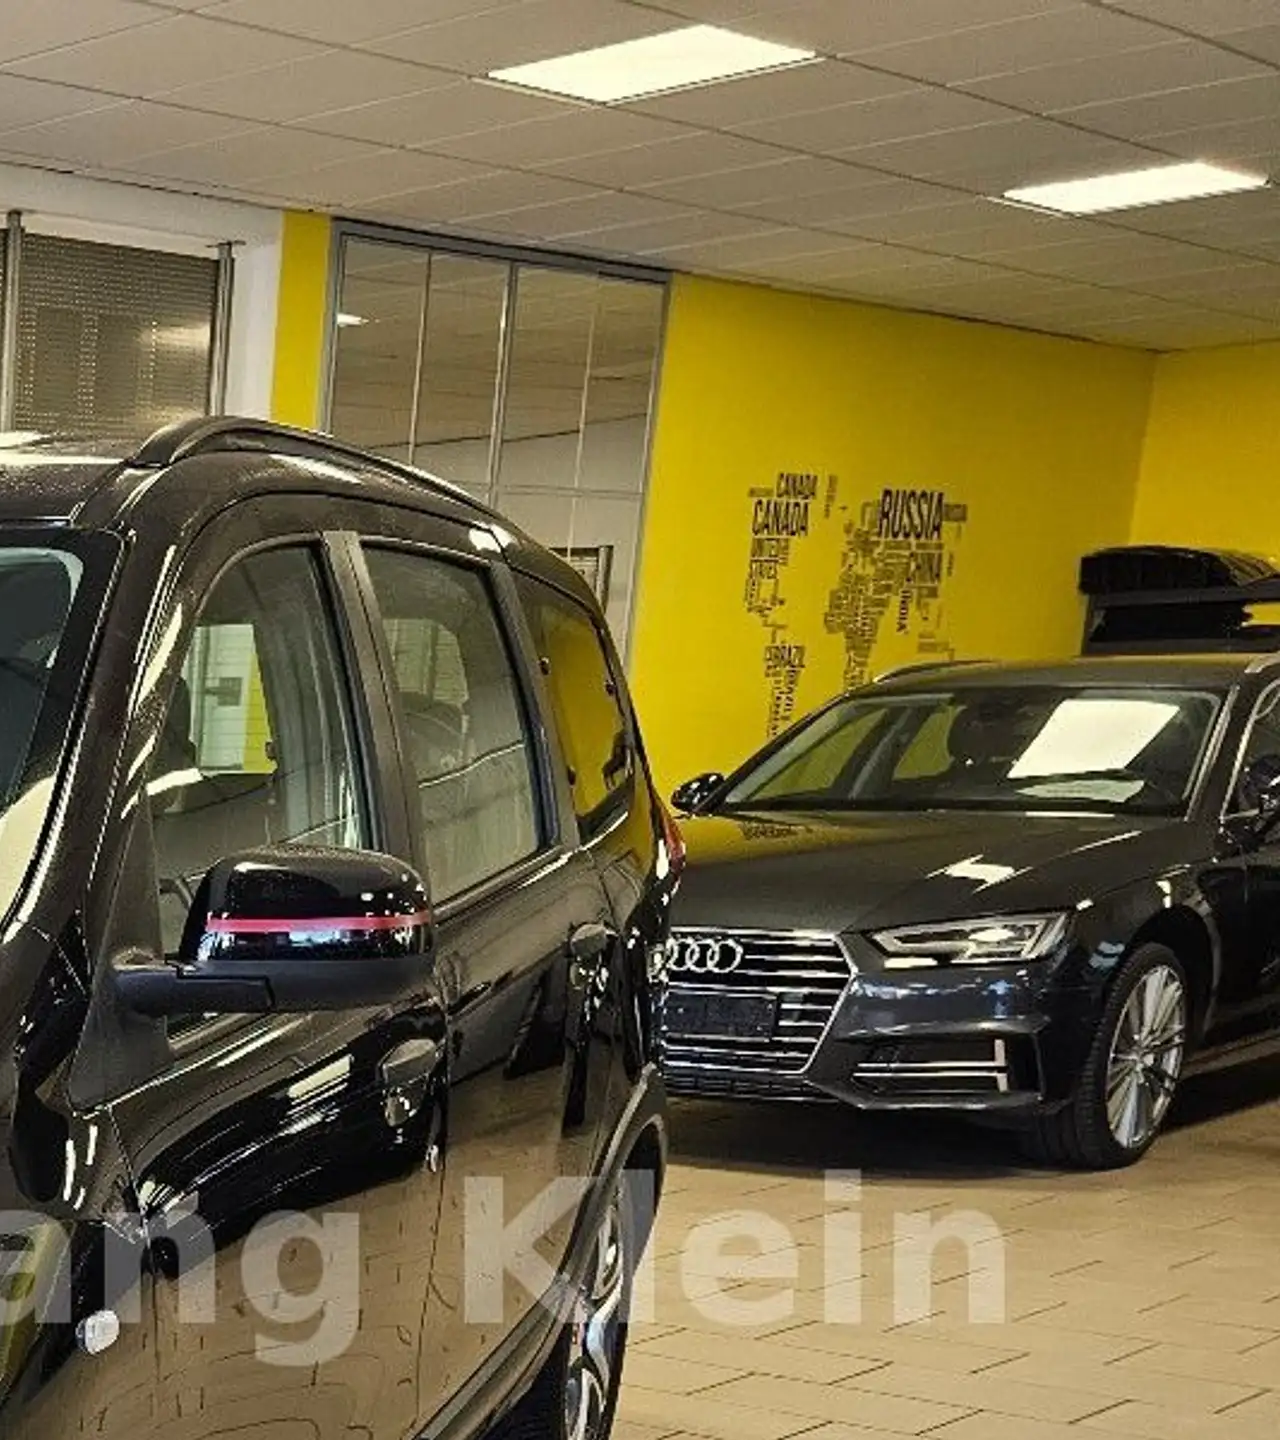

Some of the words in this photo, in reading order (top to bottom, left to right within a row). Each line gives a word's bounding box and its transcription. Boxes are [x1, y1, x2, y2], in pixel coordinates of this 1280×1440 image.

[776, 473, 818, 500] CANADA
[752, 500, 810, 537] CANADA
[877, 488, 945, 540] RUSSIA
